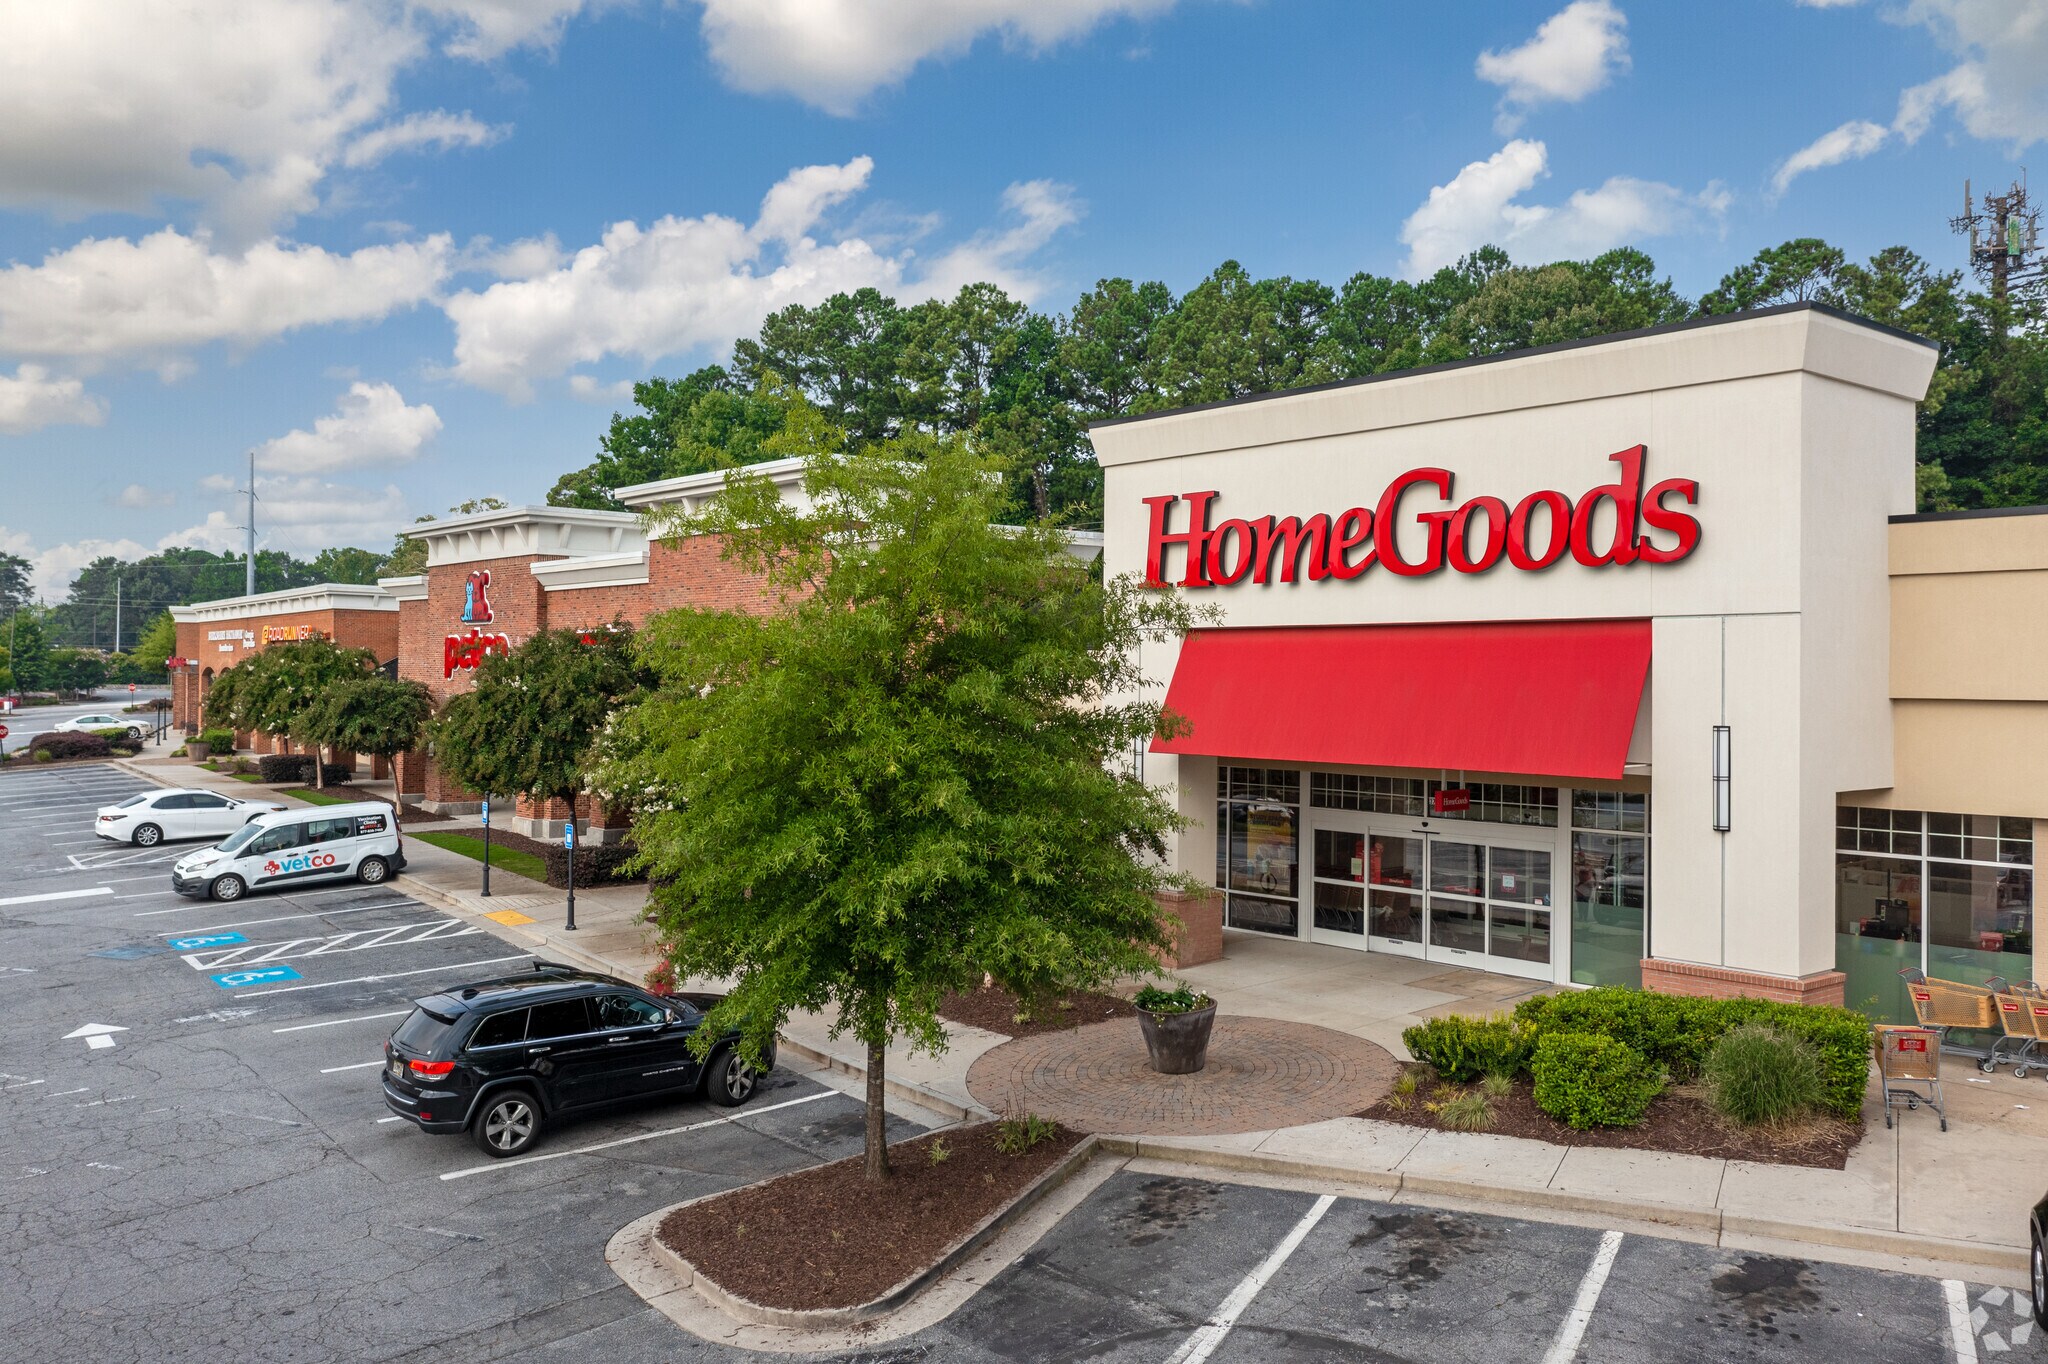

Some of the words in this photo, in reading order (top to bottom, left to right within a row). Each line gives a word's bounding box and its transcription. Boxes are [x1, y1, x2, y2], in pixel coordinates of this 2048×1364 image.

[1138, 443, 1700, 589] HomeGoods
[1443, 796, 1468, 806] HomeGoods
[280, 853, 336, 873] vetco
